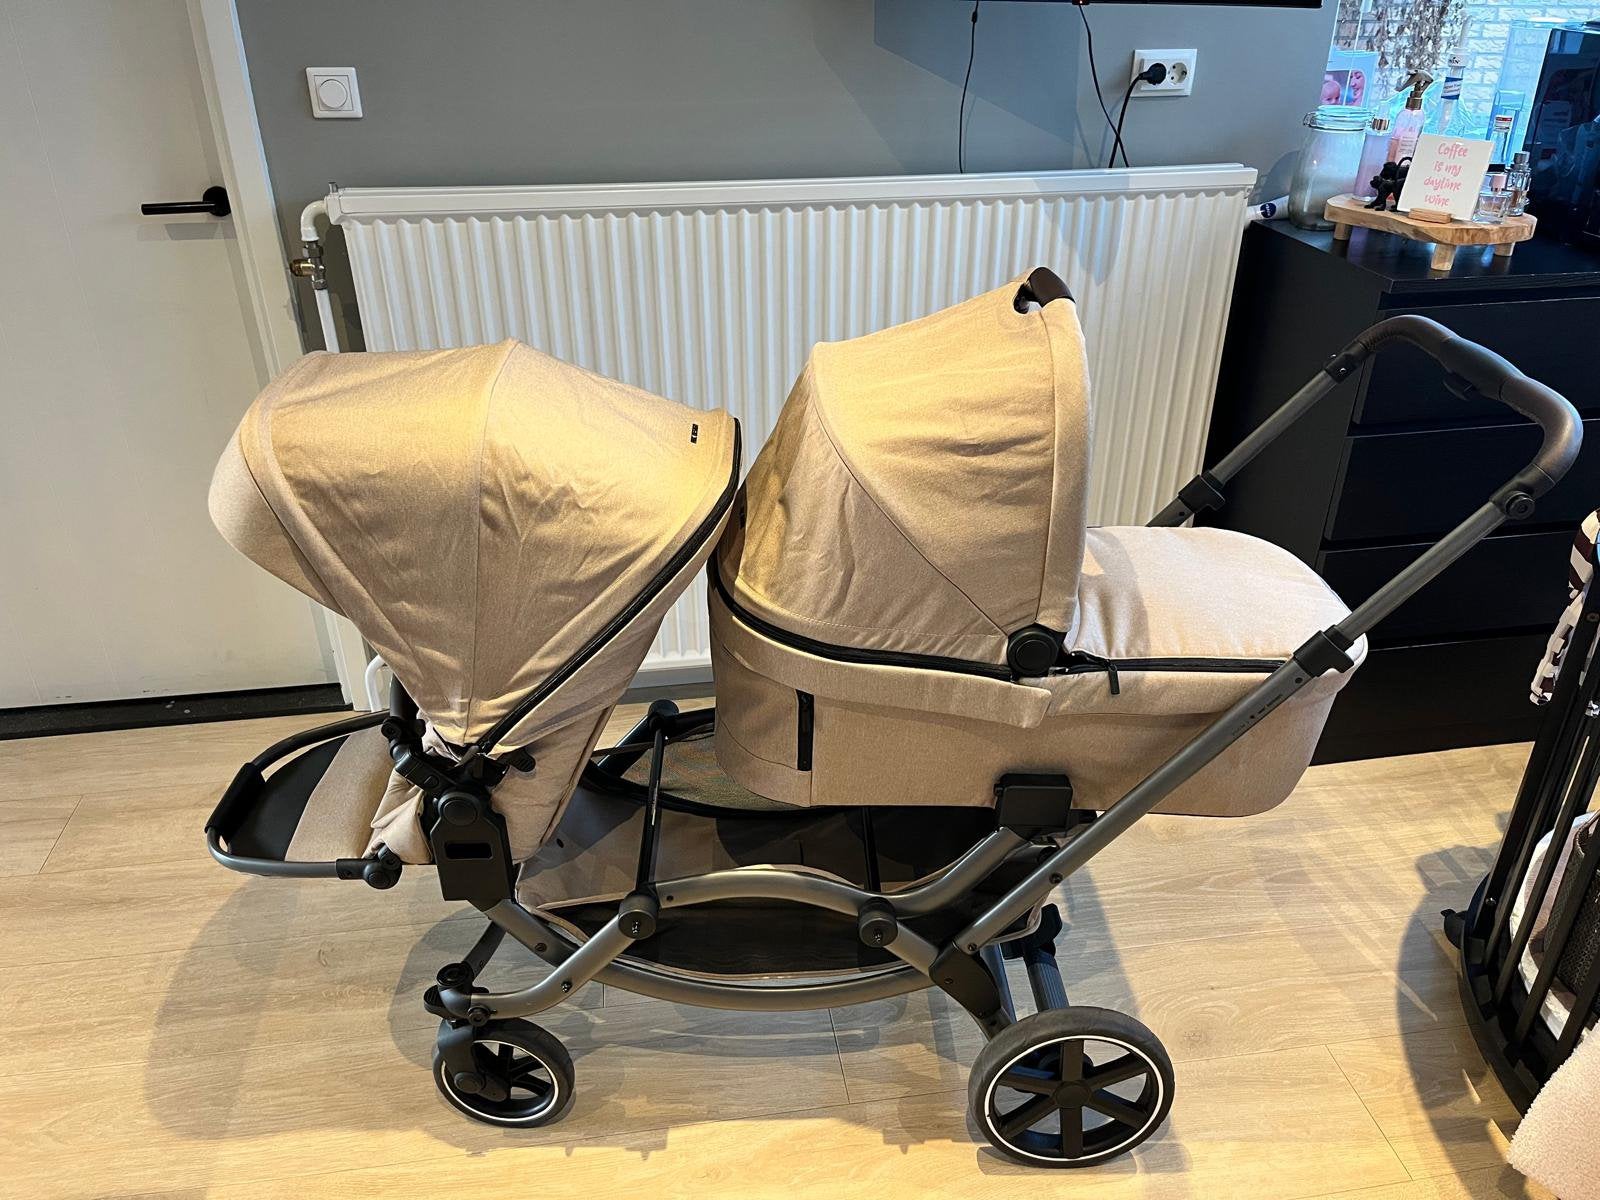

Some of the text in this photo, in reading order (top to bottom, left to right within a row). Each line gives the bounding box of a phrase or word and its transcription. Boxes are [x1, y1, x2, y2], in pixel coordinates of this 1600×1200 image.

[1438, 143, 1468, 159] Coffee
[1434, 161, 1462, 177] is my
[1424, 176, 1462, 191] daytime
[1425, 194, 1450, 207] wine
